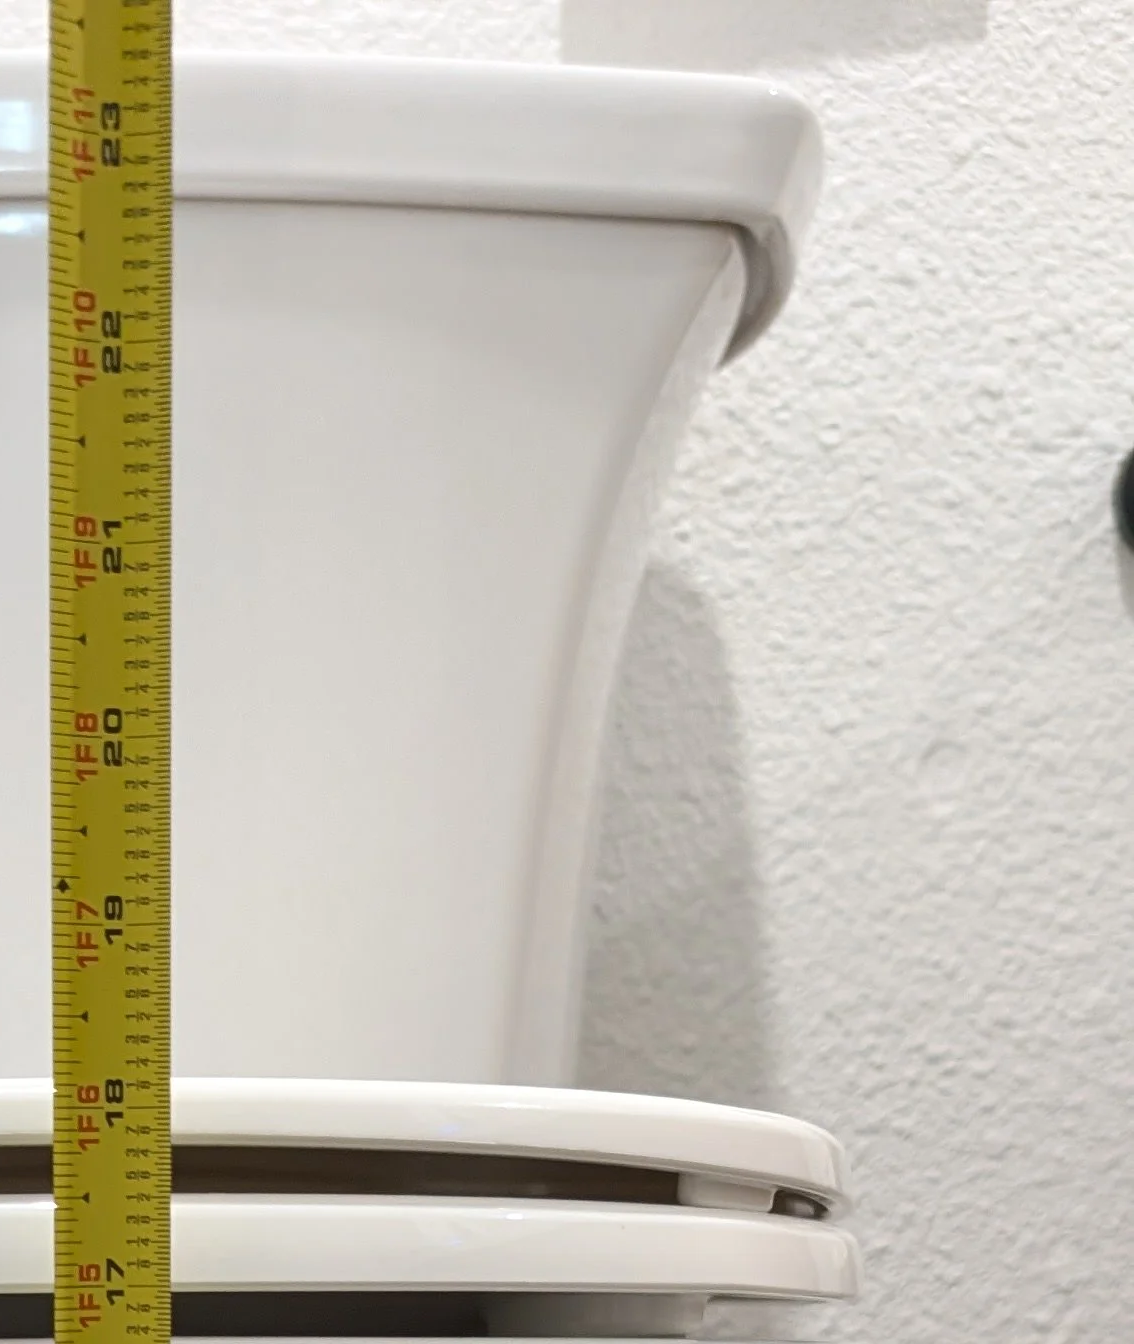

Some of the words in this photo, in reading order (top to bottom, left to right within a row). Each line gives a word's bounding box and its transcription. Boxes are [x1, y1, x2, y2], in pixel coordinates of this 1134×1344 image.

[101, 102, 121, 167] 23
[101, 311, 122, 374] 22
[102, 519, 123, 574] 21
[103, 707, 123, 767] 20
[104, 895, 124, 945] 19
[105, 1078, 124, 1128] 18
[106, 1258, 125, 1306] 17
